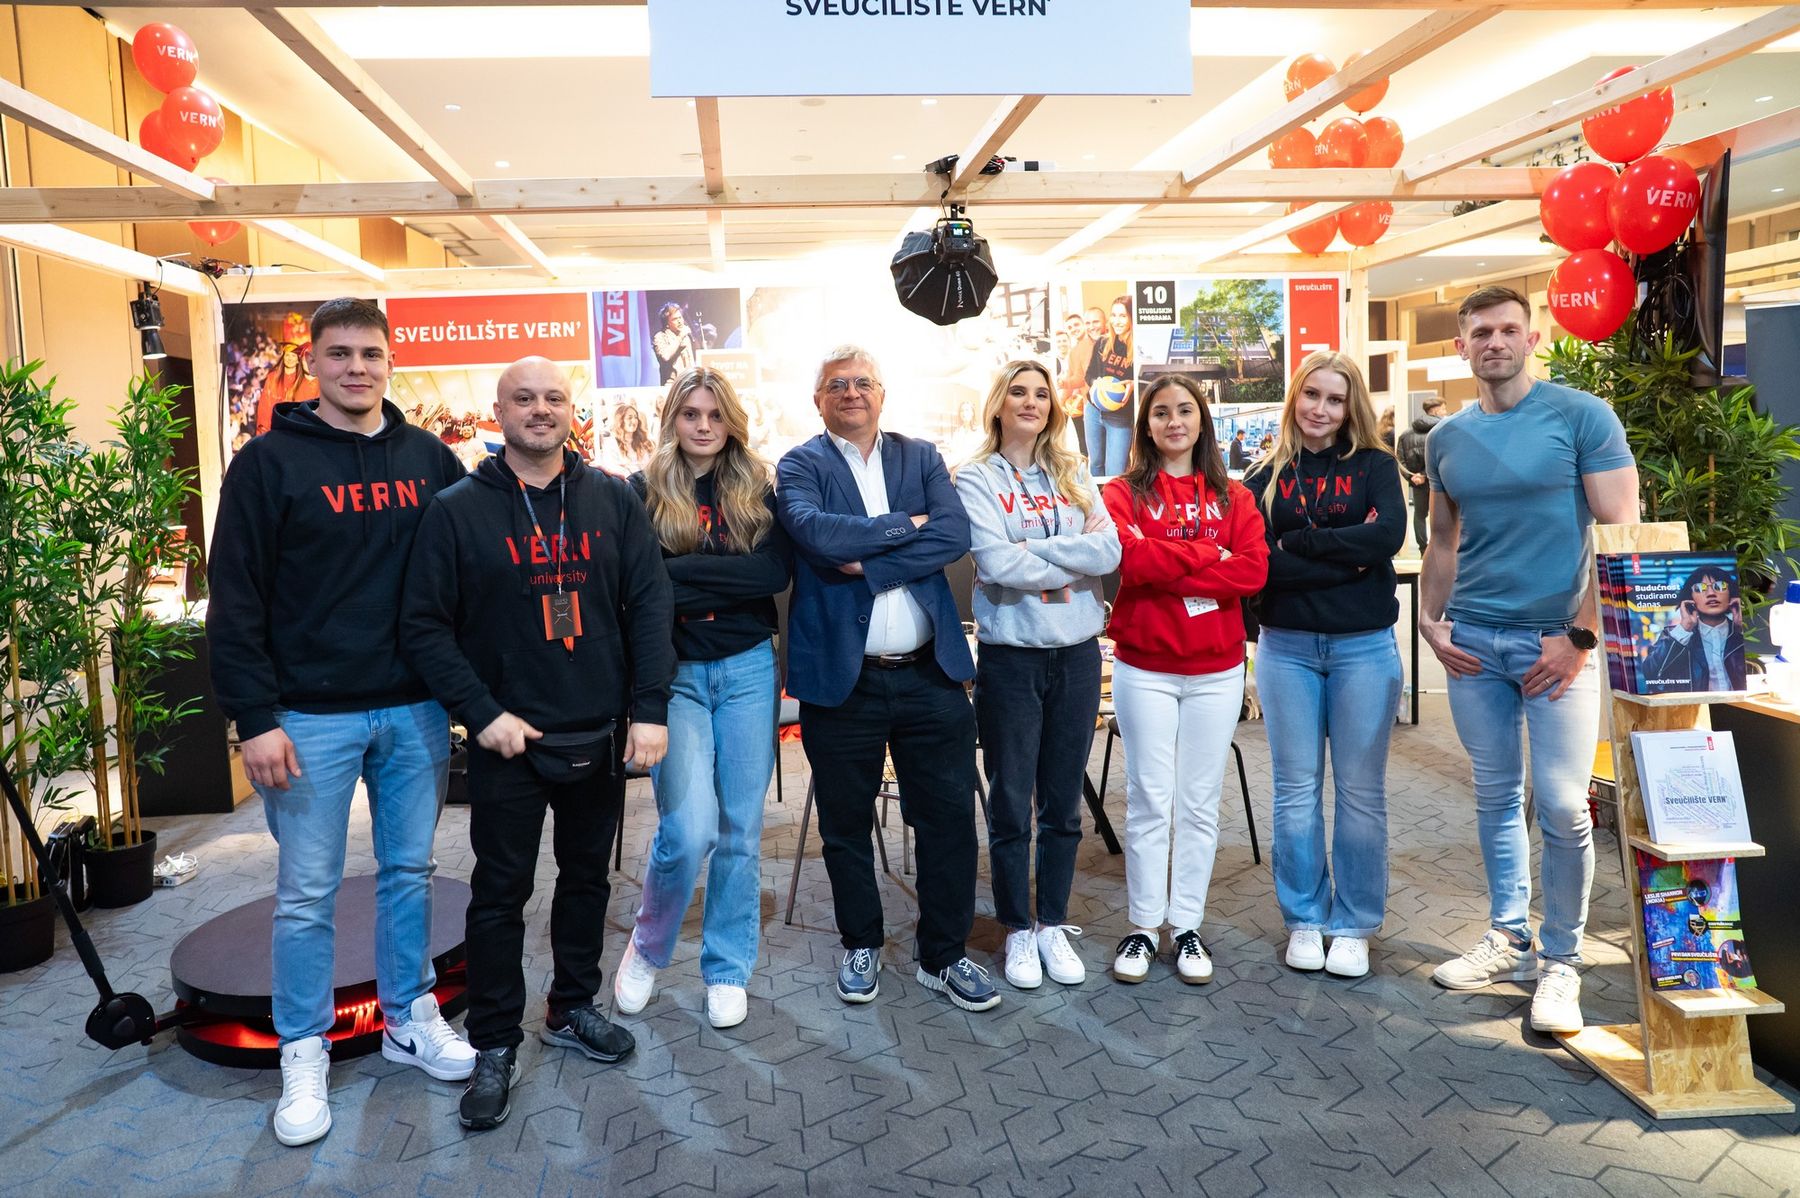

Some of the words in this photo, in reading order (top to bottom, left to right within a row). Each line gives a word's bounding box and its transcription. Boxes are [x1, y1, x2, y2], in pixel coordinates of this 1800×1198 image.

[1143, 286, 1168, 304] 10
[394, 320, 519, 344] SVEUČILIŠTE
[524, 320, 582, 339] VERN'
[1635, 584, 1680, 592] Budućnost
